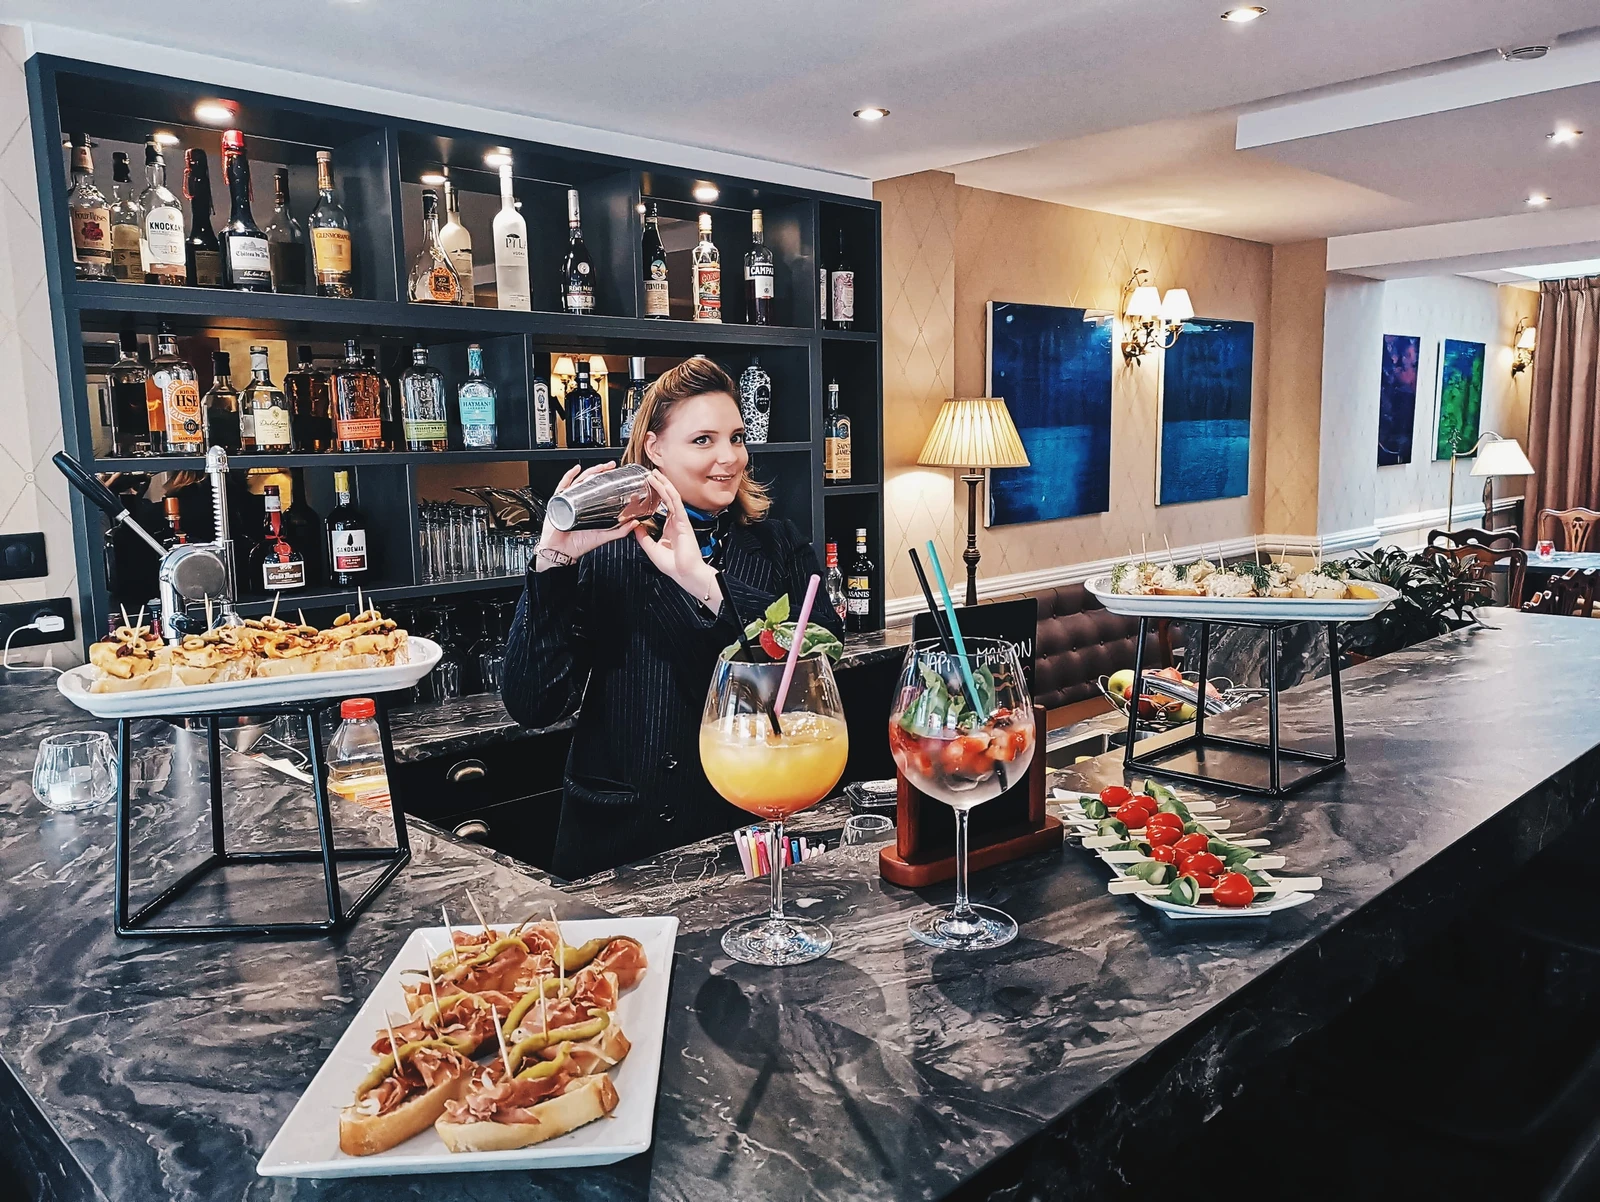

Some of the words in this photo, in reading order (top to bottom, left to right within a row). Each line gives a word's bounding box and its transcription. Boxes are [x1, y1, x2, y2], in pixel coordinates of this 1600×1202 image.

[149, 221, 182, 231] KNOCKAN
[750, 266, 774, 275] CAMPA
[175, 394, 199, 407] HSE
